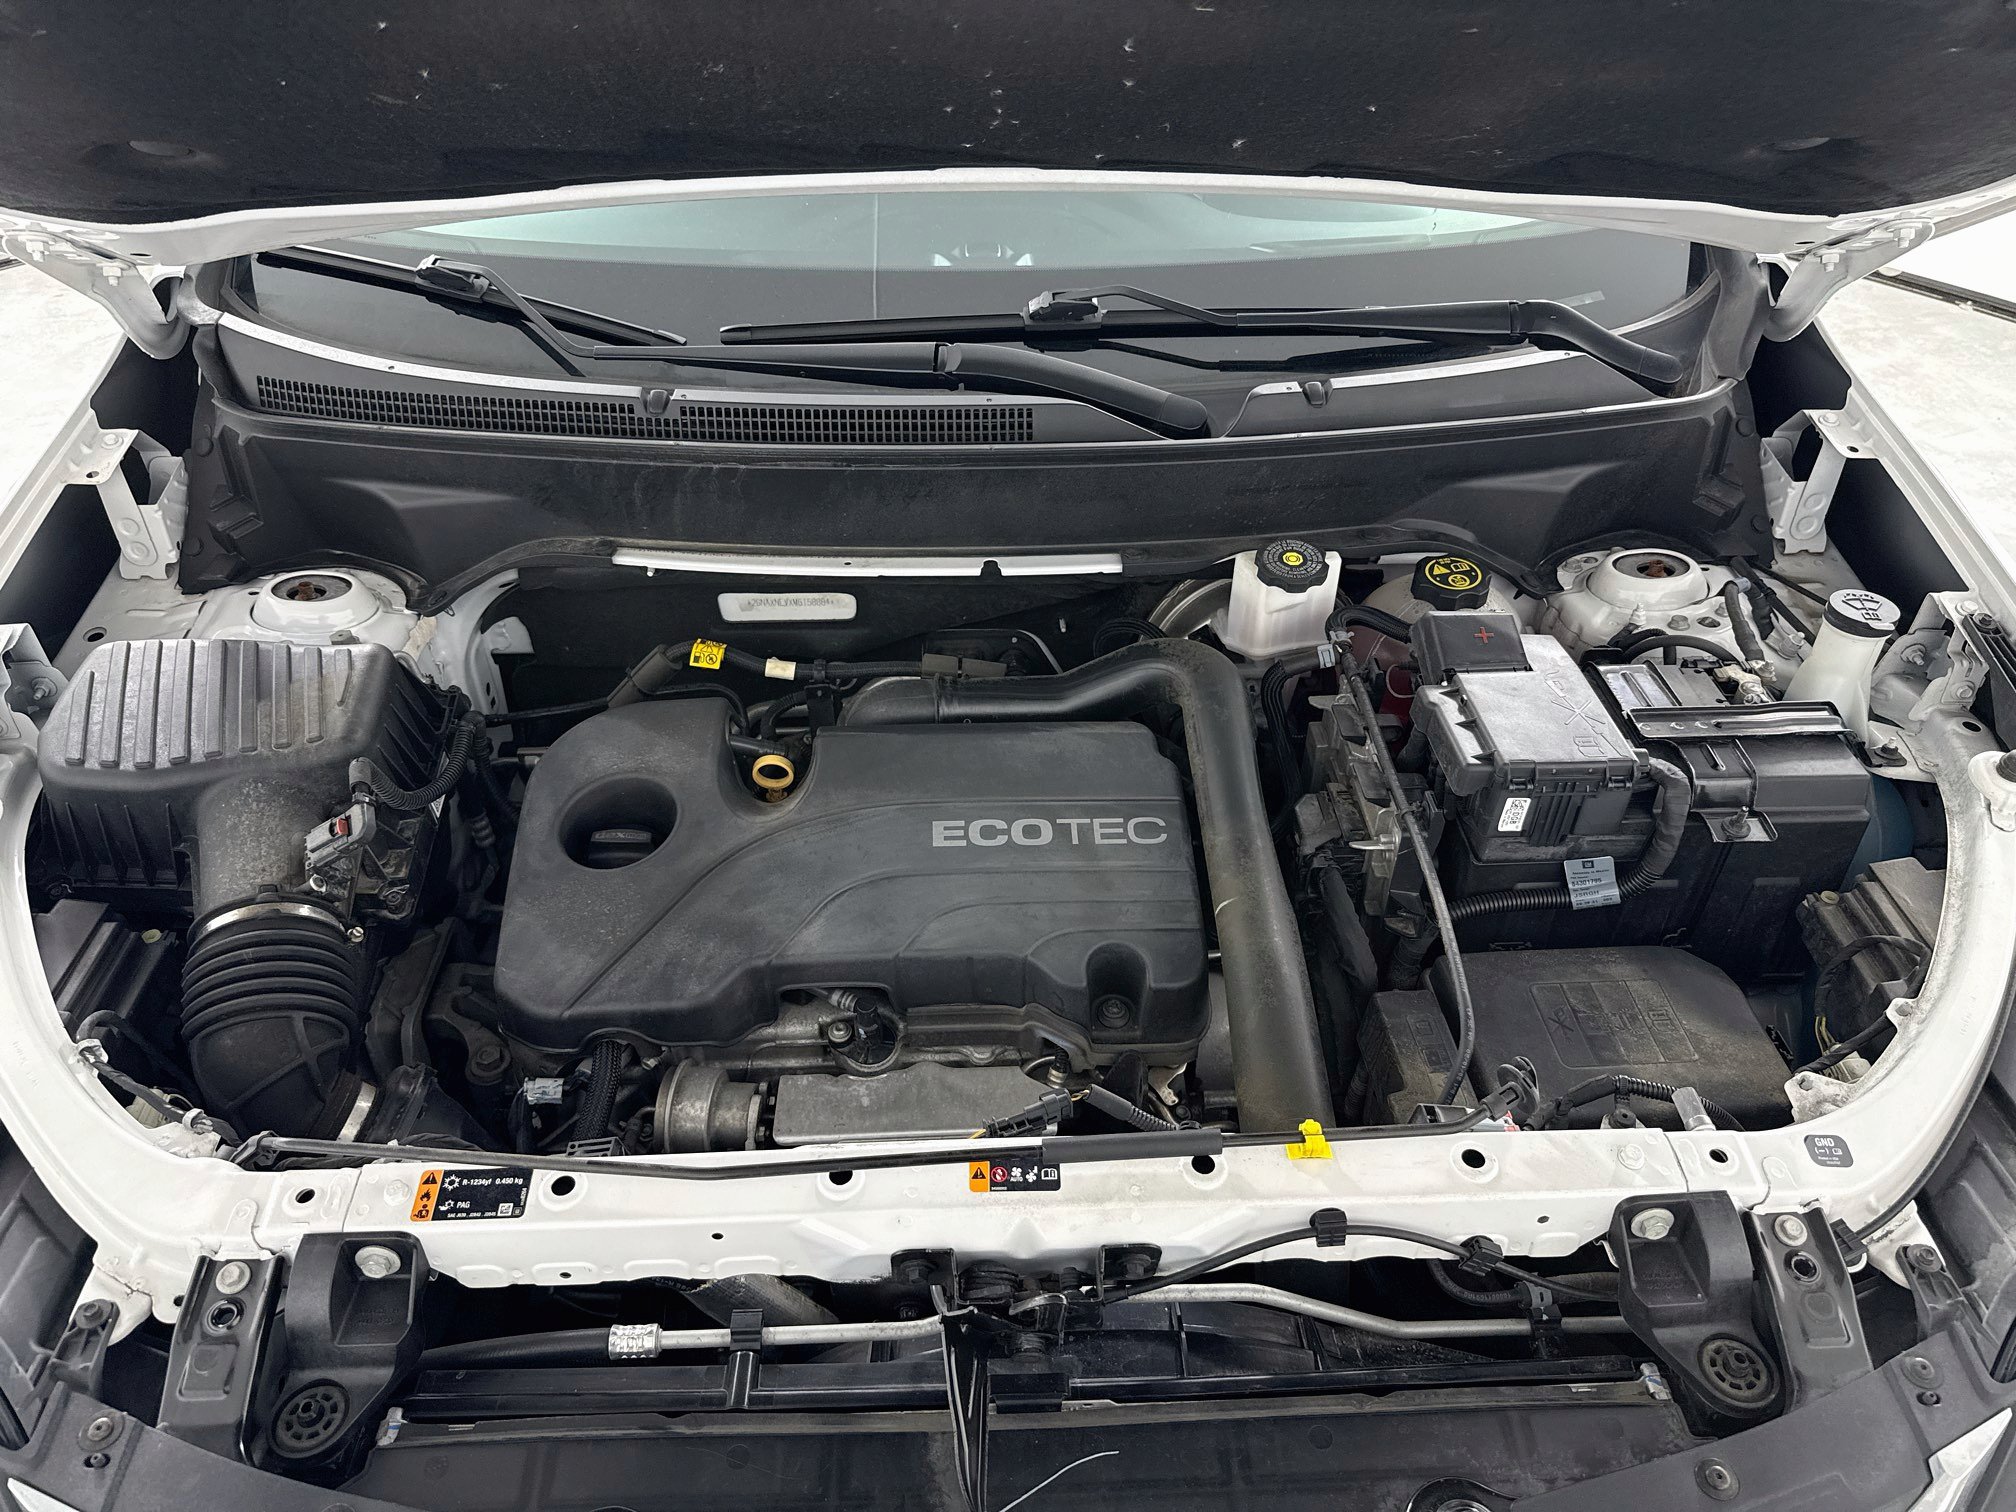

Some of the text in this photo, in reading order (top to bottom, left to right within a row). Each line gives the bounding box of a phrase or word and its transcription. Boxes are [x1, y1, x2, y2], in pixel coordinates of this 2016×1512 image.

[932, 817, 1168, 847] ECOTEC
[1814, 1137, 1835, 1147] GND
[462, 1177, 524, 1186] R-1234yf 0.450 kg
[456, 1201, 471, 1209] PAG
